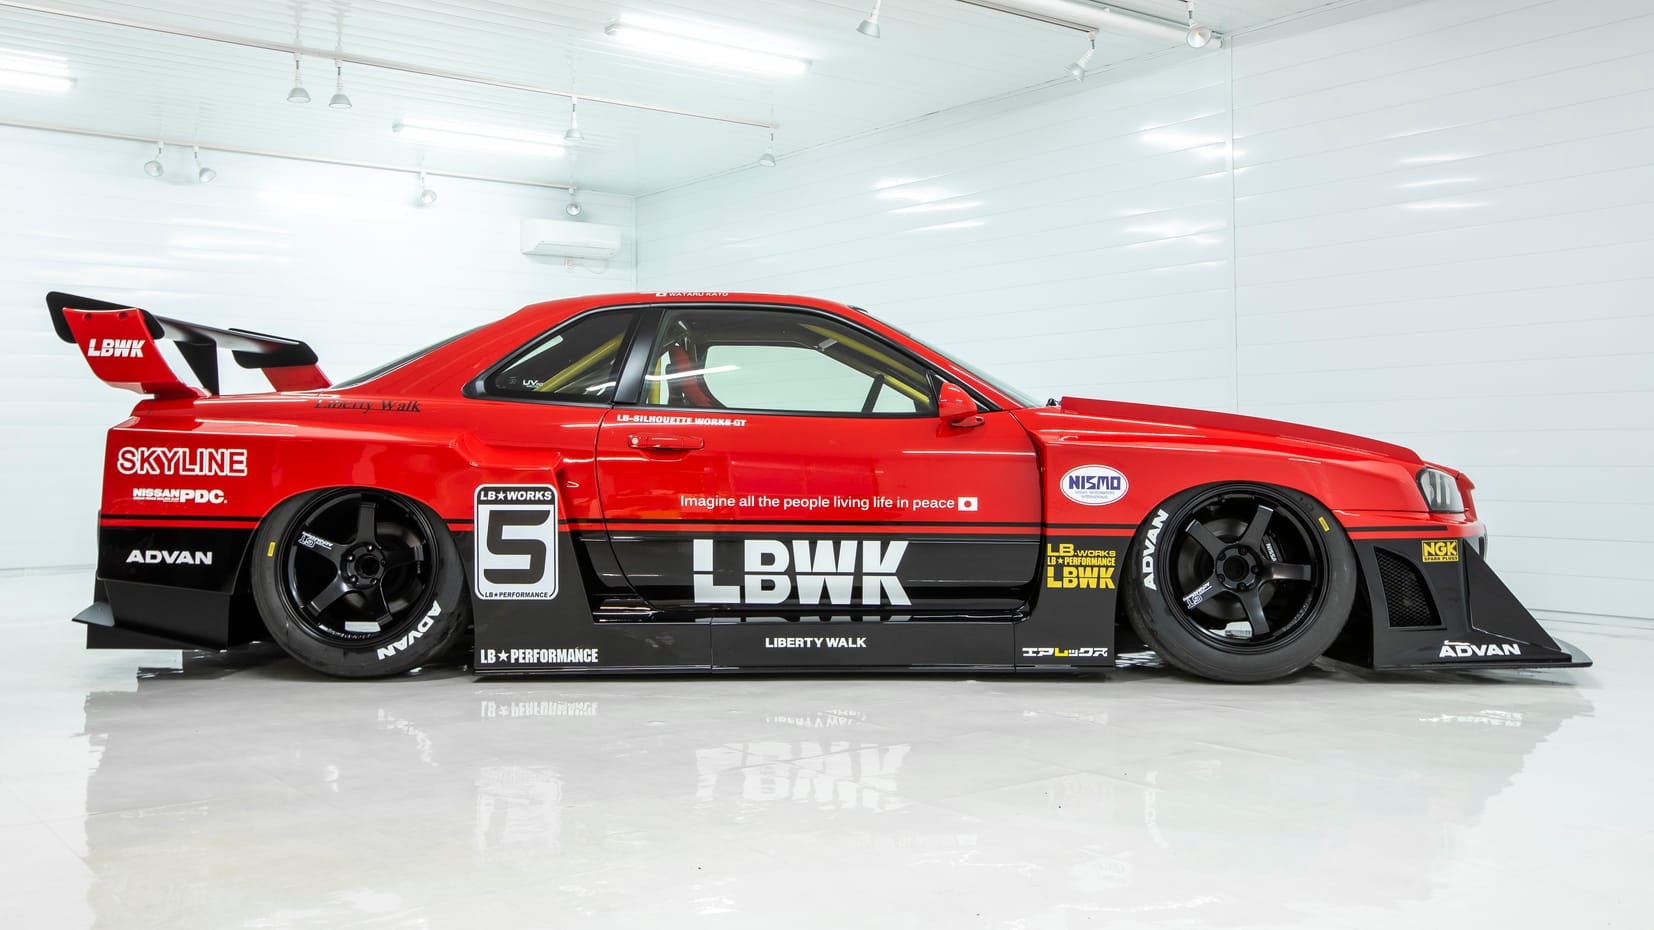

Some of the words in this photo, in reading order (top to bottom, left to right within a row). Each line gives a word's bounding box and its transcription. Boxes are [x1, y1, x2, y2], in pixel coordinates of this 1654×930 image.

[87, 338, 146, 358] LBWK
[381, 399, 421, 412] Walk
[616, 414, 693, 425] LB-SILHOUETTE
[117, 446, 248, 476] SKYLINE
[1068, 475, 1121, 490] NISMO
[132, 488, 180, 497] NISSAN
[680, 495, 737, 510] Imagine
[739, 495, 755, 507] all
[758, 495, 780, 507] the
[783, 496, 830, 511] people
[833, 496, 870, 511] living
[873, 496, 894, 508] life
[897, 496, 909, 508] in
[912, 499, 956, 511] peace
[483, 510, 551, 584] 5
[1142, 509, 1170, 591] ADVAN
[1265, 543, 1277, 562] NISSA
[1423, 542, 1457, 557] NGK
[125, 550, 213, 565] ADVAN
[1064, 557, 1116, 566] PERFORMANCE
[693, 539, 912, 605] LBWK
[1047, 566, 1116, 589] LBWK
[377, 600, 441, 660] ADVAN
[765, 637, 823, 648] LIBERTY
[826, 637, 867, 648] WALK
[510, 648, 599, 663] PERFORMANCE
[1439, 643, 1521, 658] ADVAN
